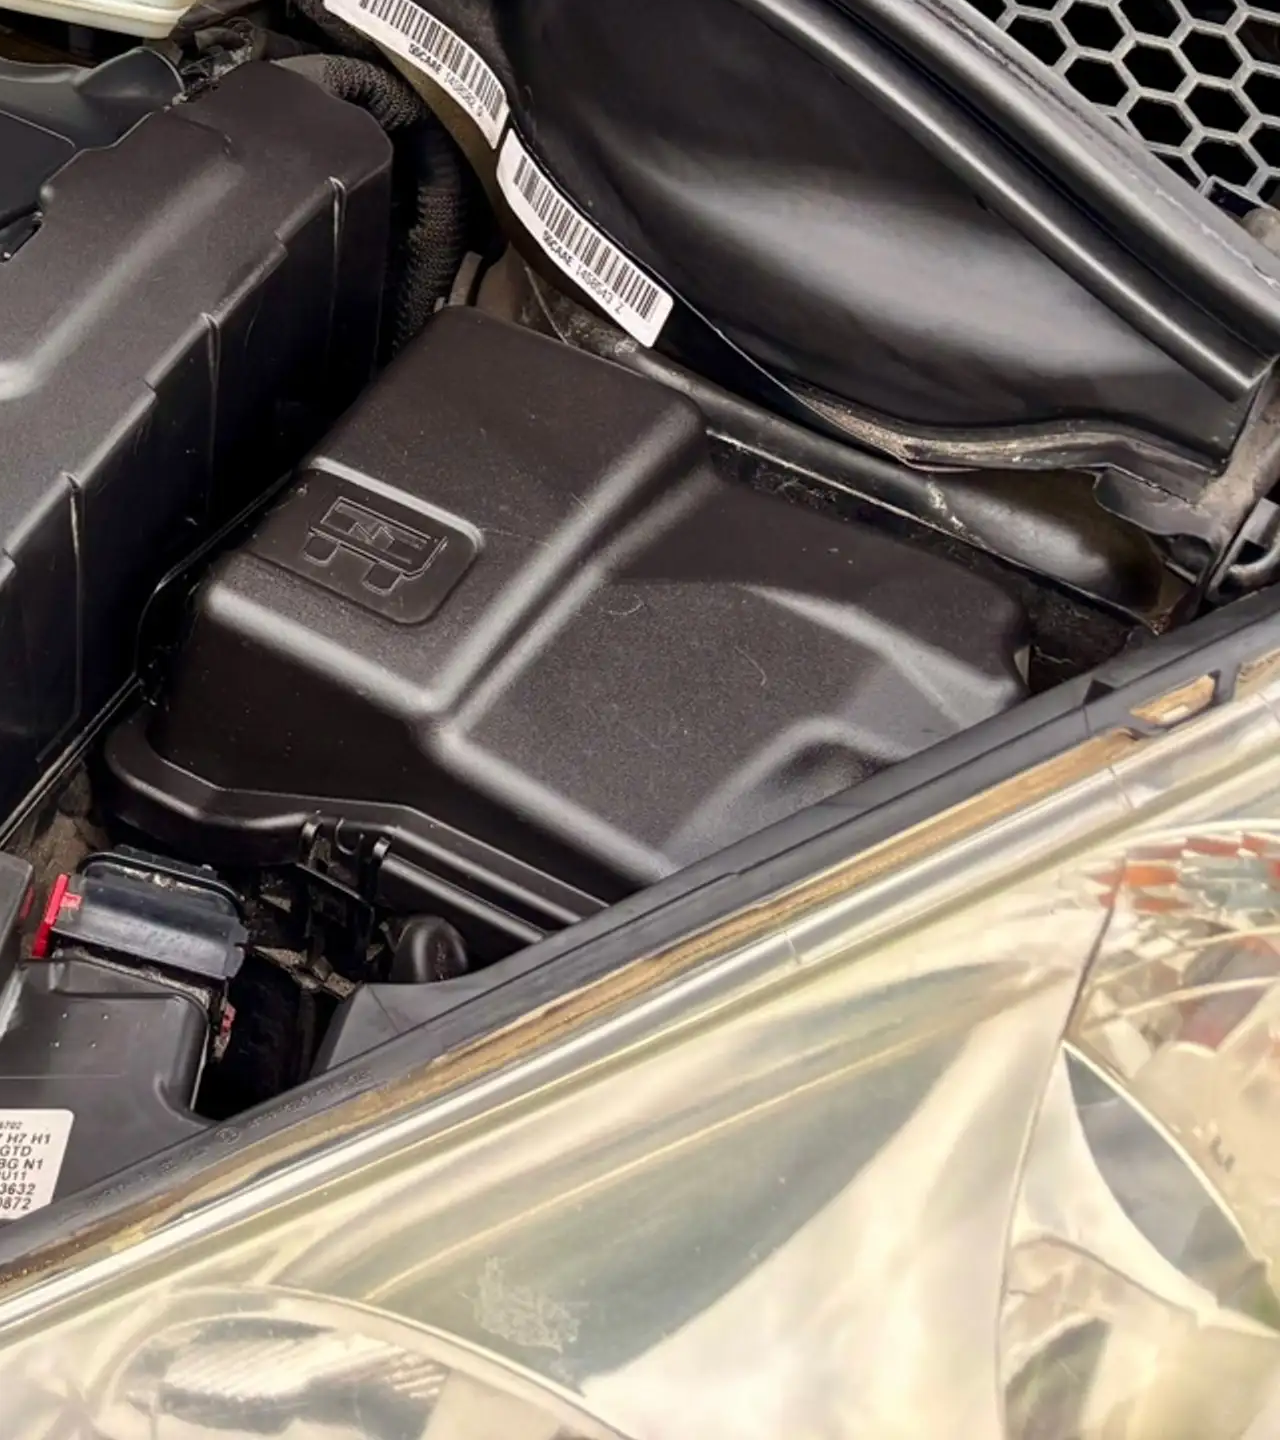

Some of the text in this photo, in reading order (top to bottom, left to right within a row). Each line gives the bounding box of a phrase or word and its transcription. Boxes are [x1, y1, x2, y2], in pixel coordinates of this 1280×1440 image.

[6, 1133, 28, 1145] H7
[30, 1133, 52, 1146] H1
[23, 1158, 44, 1171] N1
